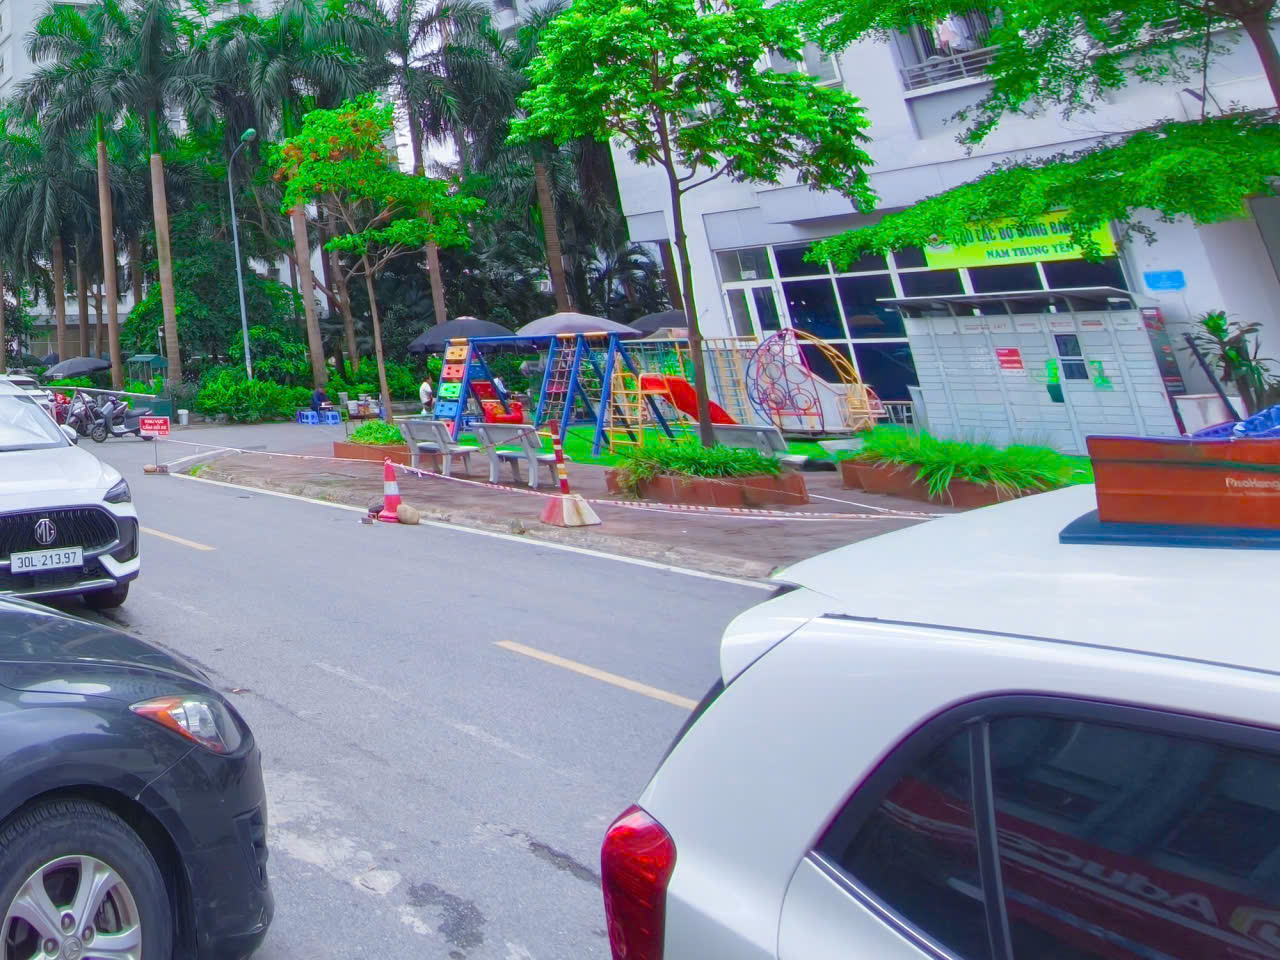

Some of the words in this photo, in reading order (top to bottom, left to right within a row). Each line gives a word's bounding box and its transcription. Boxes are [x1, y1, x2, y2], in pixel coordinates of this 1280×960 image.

[985, 248, 1010, 259] NAM
[1012, 245, 1049, 257] TRUNG
[35, 519, 56, 544] MG
